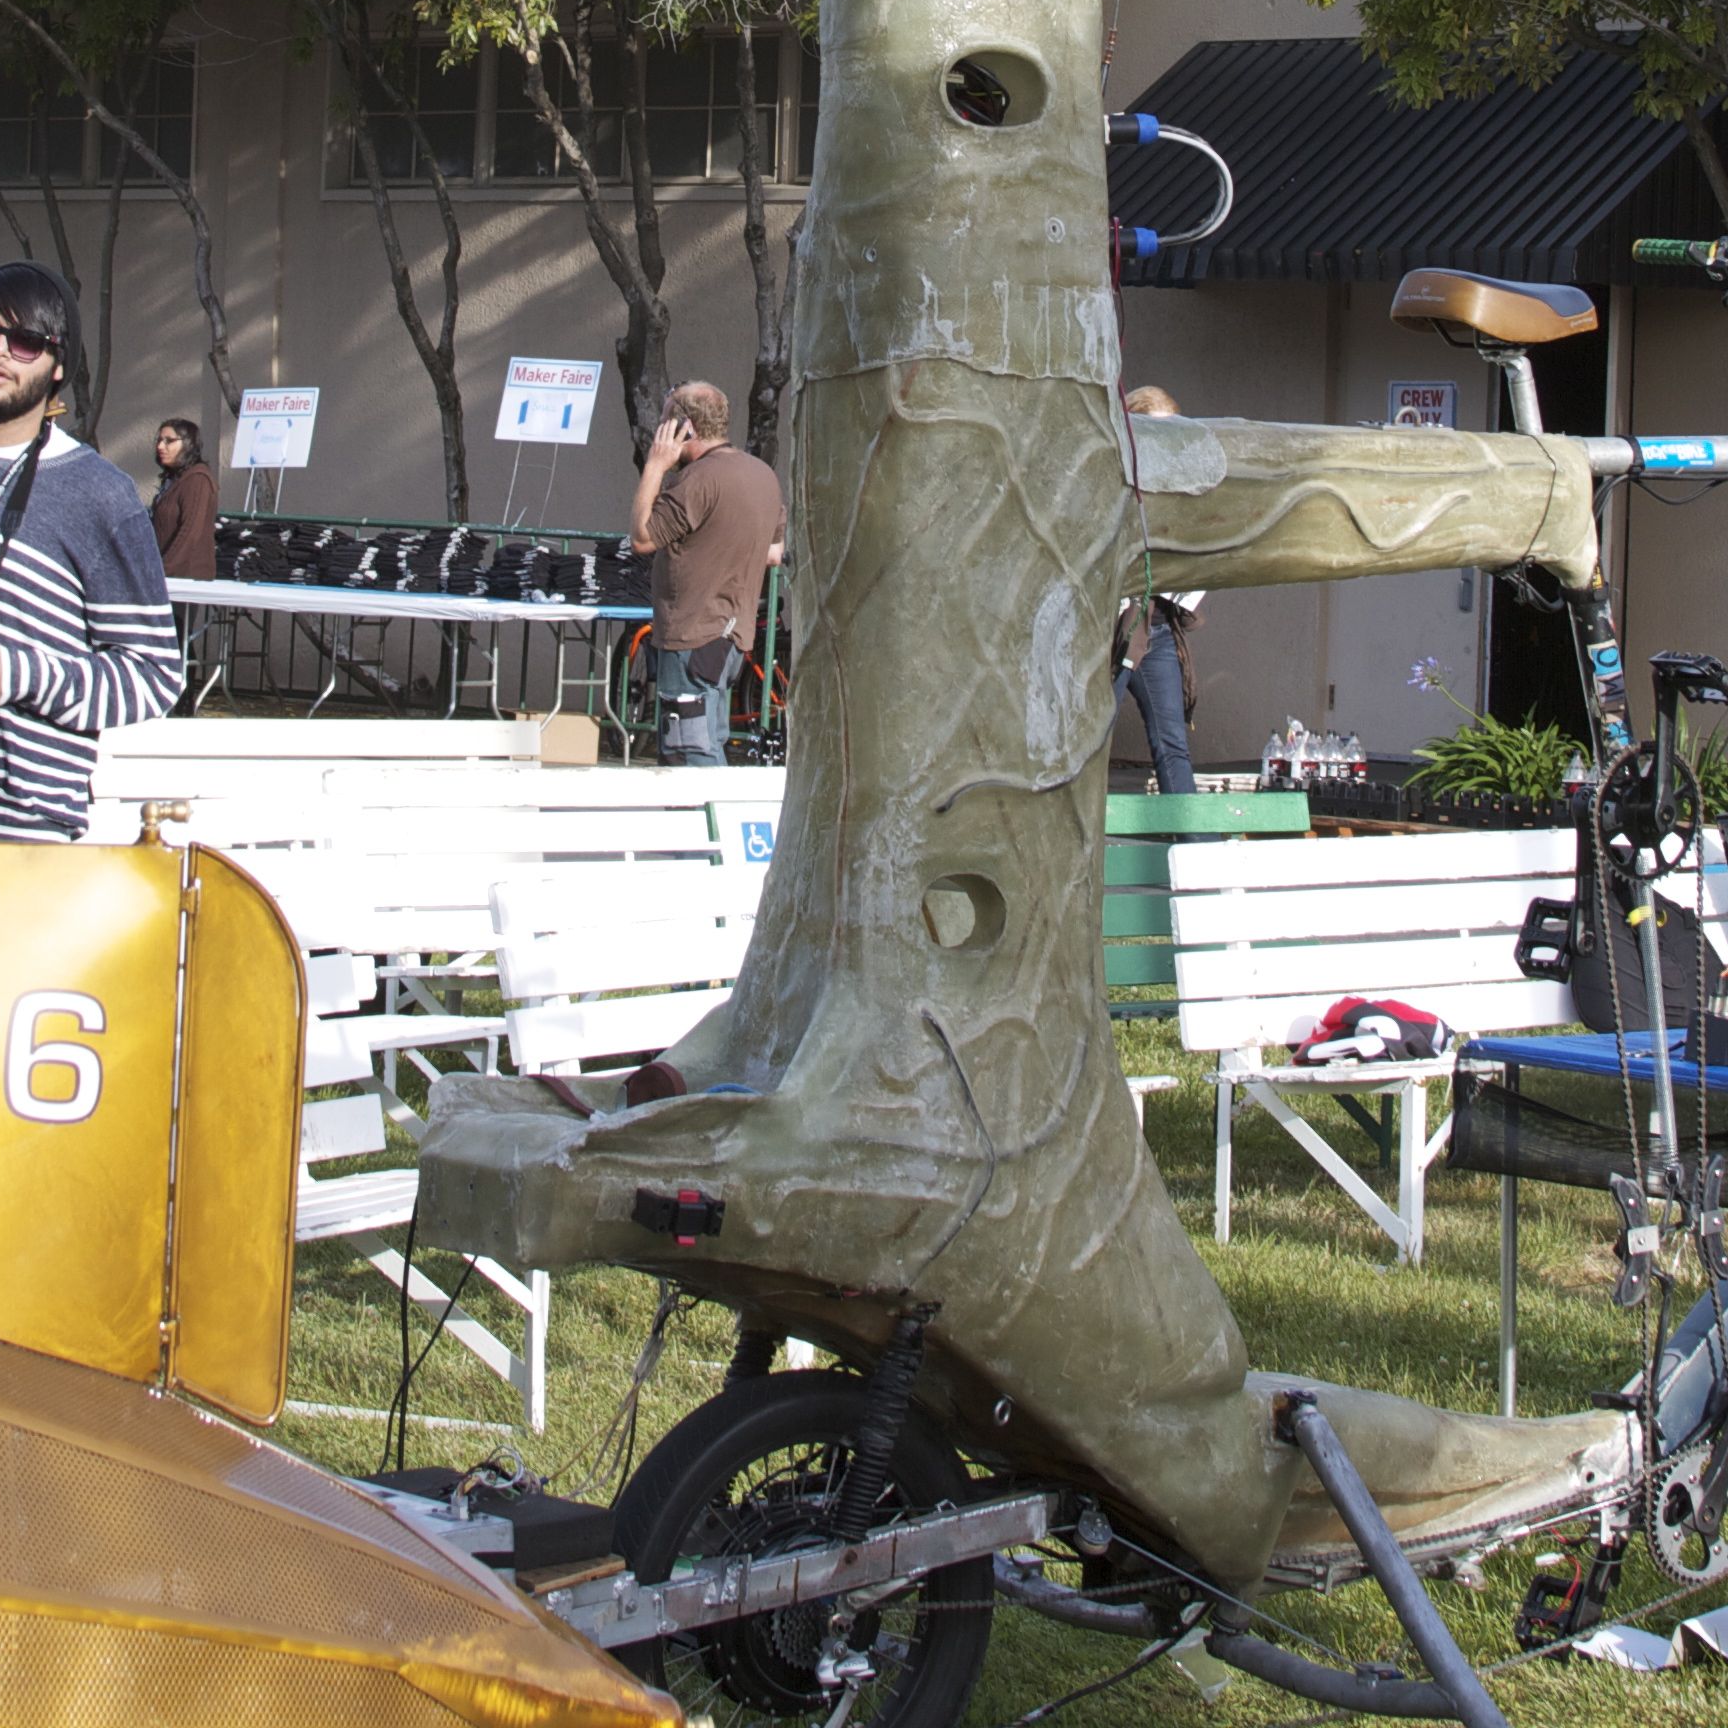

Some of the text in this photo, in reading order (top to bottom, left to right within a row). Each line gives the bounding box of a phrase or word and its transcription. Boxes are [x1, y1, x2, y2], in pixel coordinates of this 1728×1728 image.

[514, 366, 593, 386] Maker Faire
[246, 396, 311, 412] Maker Faire
[1400, 389, 1444, 408] CREW
